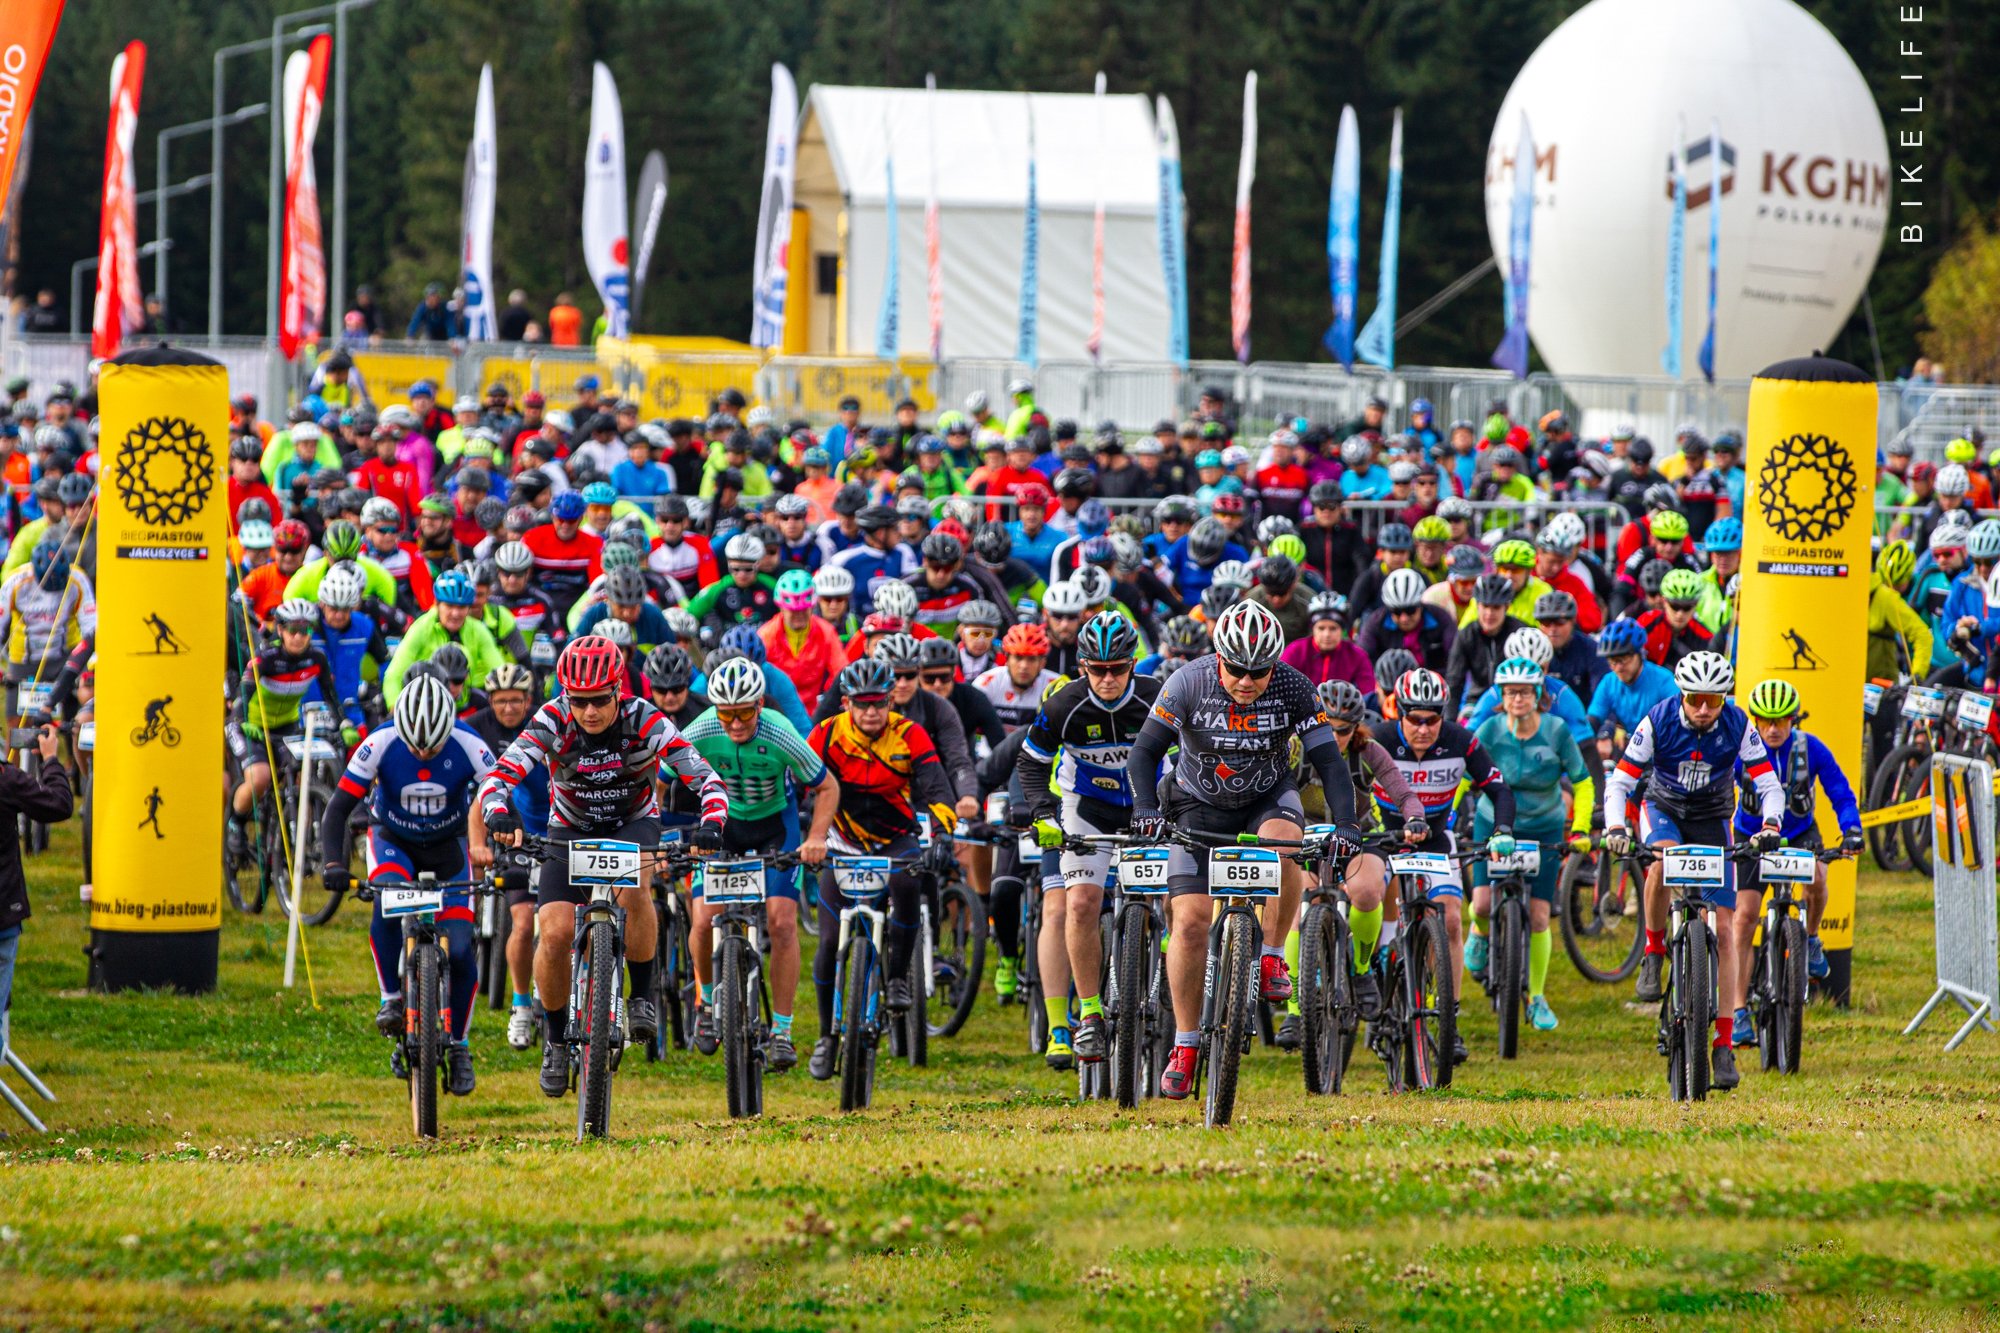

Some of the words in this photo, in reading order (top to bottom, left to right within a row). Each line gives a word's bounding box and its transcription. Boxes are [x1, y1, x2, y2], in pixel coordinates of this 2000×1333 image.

[128, 547, 195, 558] JAKUSZYCE
[1769, 563, 1835, 575] JAKUSZYCE
[1192, 711, 1289, 732] MARCELI
[1211, 736, 1270, 751] TEAM
[1402, 767, 1459, 784] BRISK
[587, 855, 619, 869] 755
[1679, 859, 1706, 871] 736
[848, 871, 873, 884] 784
[1134, 865, 1163, 878] 657
[1227, 866, 1260, 880] 658
[711, 876, 748, 889] 1125
